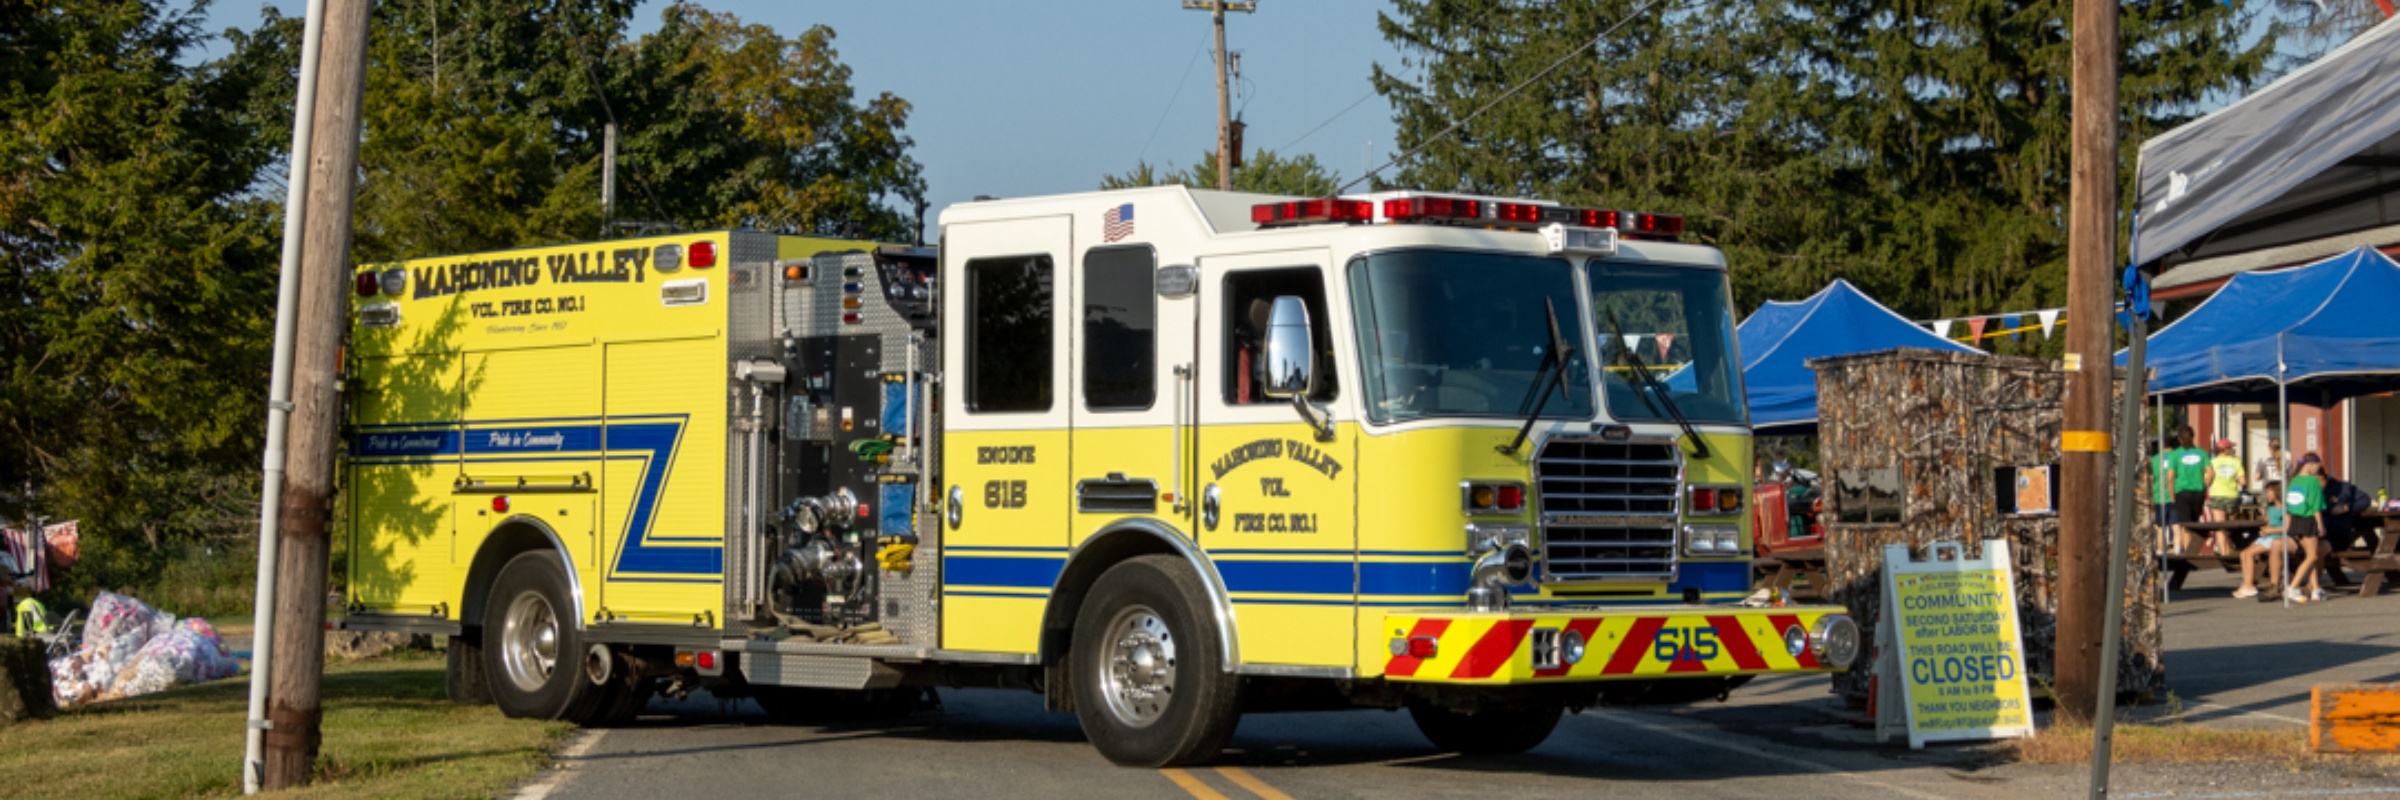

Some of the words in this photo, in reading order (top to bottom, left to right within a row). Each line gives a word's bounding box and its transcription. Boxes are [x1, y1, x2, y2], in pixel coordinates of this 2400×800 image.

[413, 257, 540, 300] MAHONING
[546, 247, 650, 283] VALLEY
[471, 301, 498, 318] VOL.
[502, 299, 532, 316] FIRE
[535, 297, 555, 314] CO.
[368, 435, 387, 450] Pride
[391, 436, 398, 449] in
[488, 431, 511, 447] Pride
[513, 432, 520, 447] in
[523, 431, 565, 451] Community
[977, 446, 1036, 465] ENGINE
[1211, 438, 1283, 481] MAHONING
[1286, 439, 1343, 481] VALLEY
[984, 479, 1028, 509] 615
[1260, 477, 1291, 497] VOL.
[1234, 512, 1266, 532] FIRE
[1268, 512, 1287, 532] CO.
[1904, 592, 2004, 610] COMMUNITY
[1906, 613, 1949, 627] SECOND
[1953, 611, 2006, 623] SATURDAY
[1915, 627, 1938, 638] after
[1942, 625, 1978, 636] LABOR
[1981, 624, 2001, 635] DAY
[1654, 626, 1719, 662] 615
[1909, 644, 1934, 656] THIS
[1936, 643, 1967, 655] ROAD
[1969, 642, 1994, 653] WILL
[1997, 641, 2011, 652] BE
[1912, 655, 2015, 685] CLOSED
[1946, 686, 1960, 696] AM
[1962, 686, 1972, 696] to
[1982, 684, 1995, 694] PM
[1917, 702, 1947, 714] THANK
[1949, 701, 1967, 713] YOU
[1969, 698, 2020, 712] NEIGHBORS
